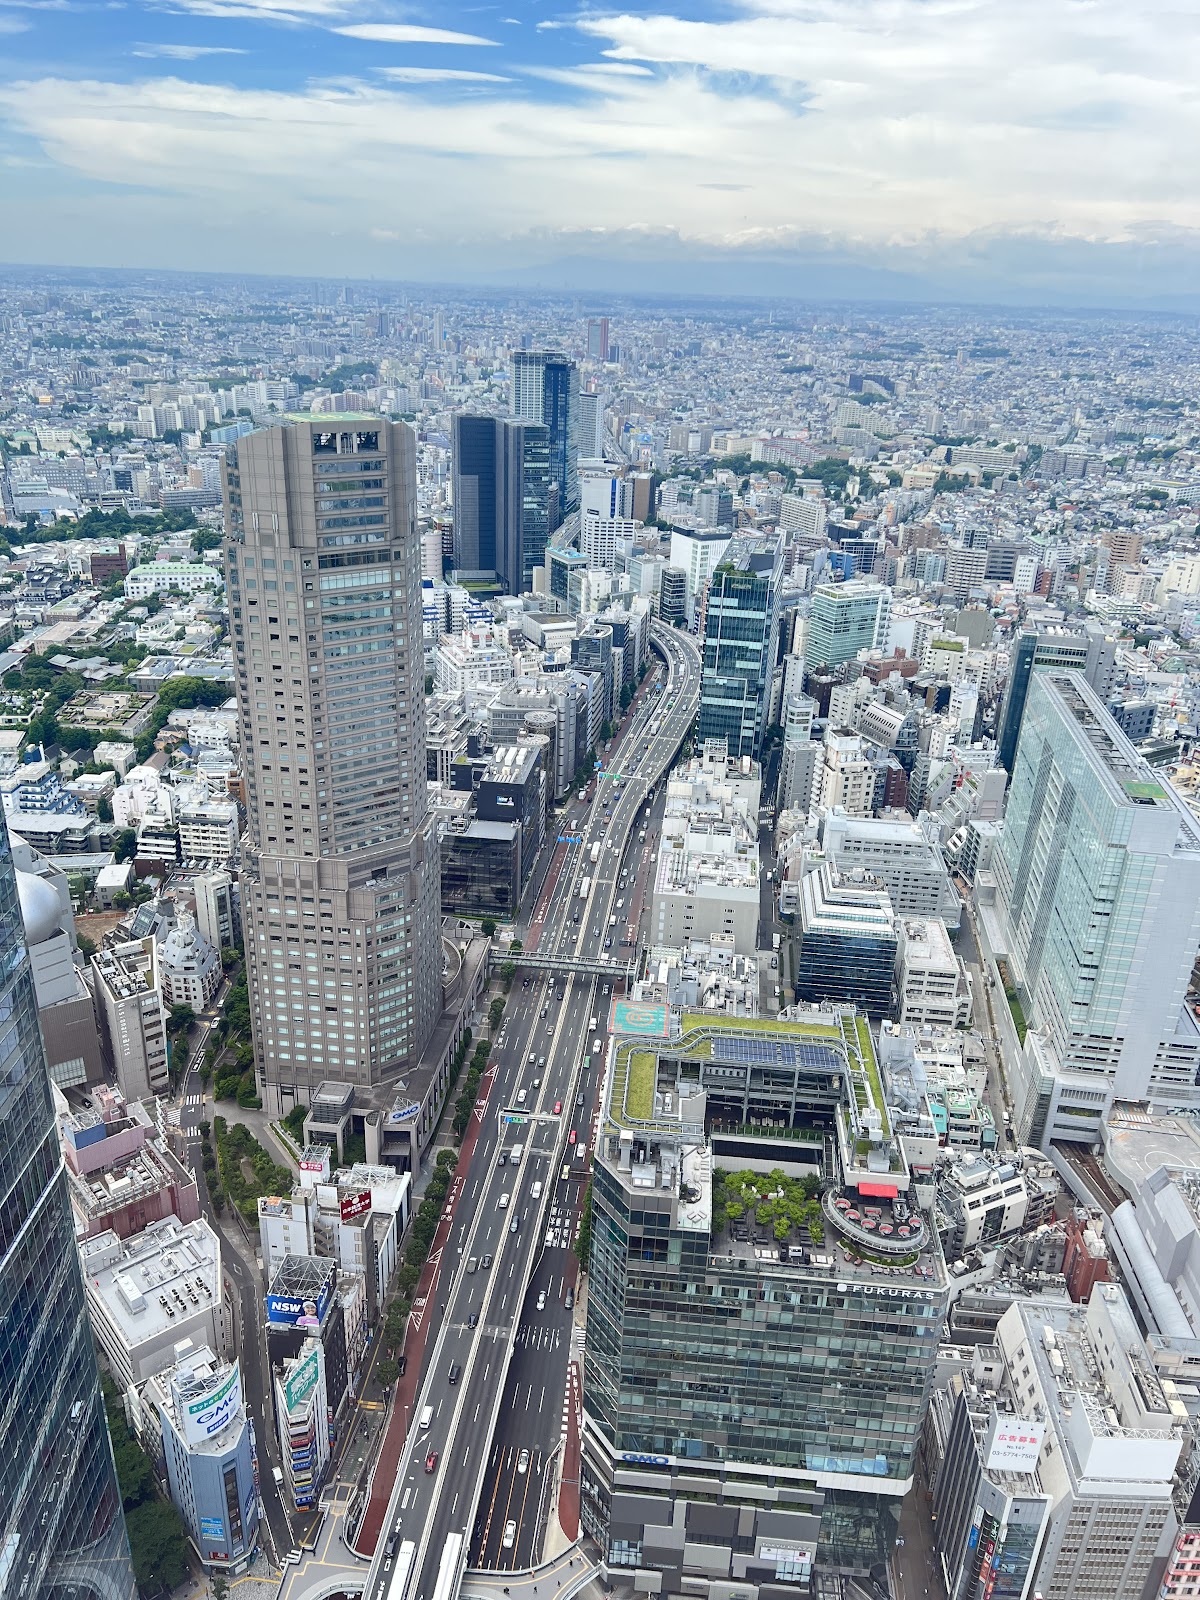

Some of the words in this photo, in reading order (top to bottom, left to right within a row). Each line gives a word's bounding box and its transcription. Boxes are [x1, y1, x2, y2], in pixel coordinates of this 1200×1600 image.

[392, 1106, 419, 1119] GMO
[852, 1285, 935, 1300] FUKURAS
[271, 1301, 302, 1313] NSW
[196, 1385, 239, 1425] GMO
[997, 1434, 1038, 1444] 広告募集
[621, 1453, 670, 1466] GMO
